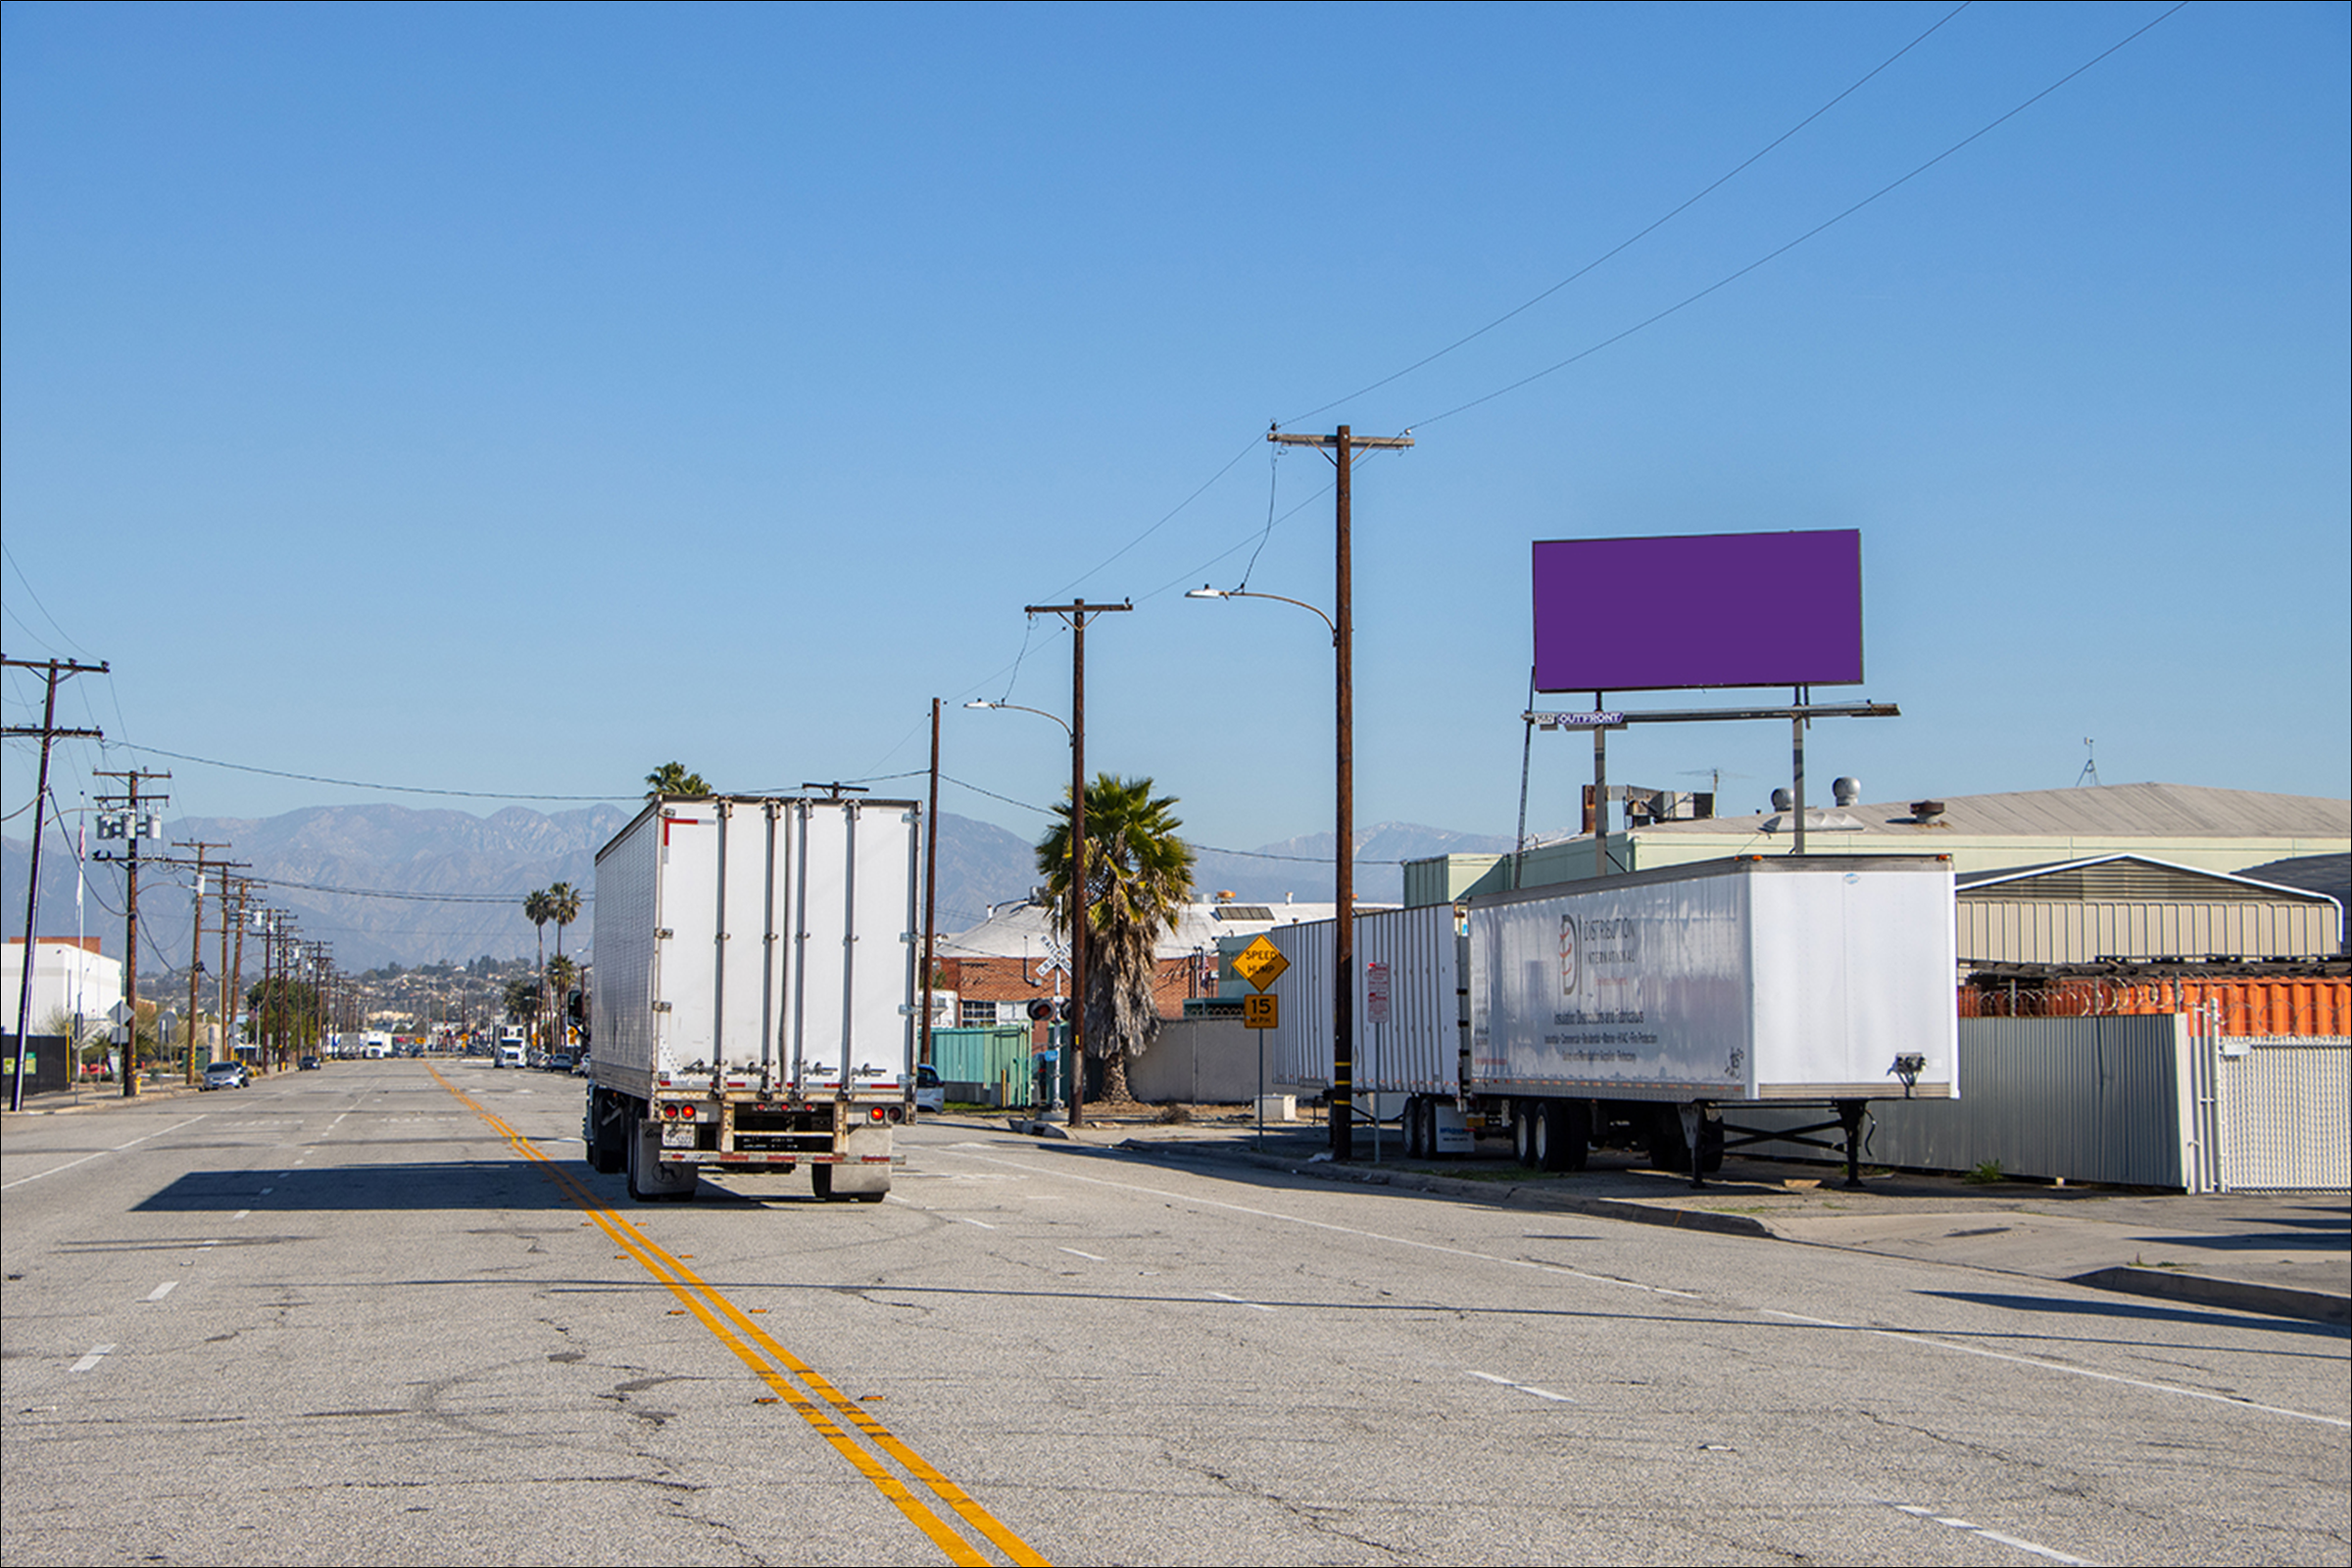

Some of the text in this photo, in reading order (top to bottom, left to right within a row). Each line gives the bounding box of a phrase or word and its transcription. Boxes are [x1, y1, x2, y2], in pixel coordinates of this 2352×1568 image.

[1558, 711, 1623, 724] OUTFRONT
[1246, 950, 1278, 960] SPEED
[1248, 964, 1275, 975] HUMP
[1251, 998, 1271, 1014] 15
